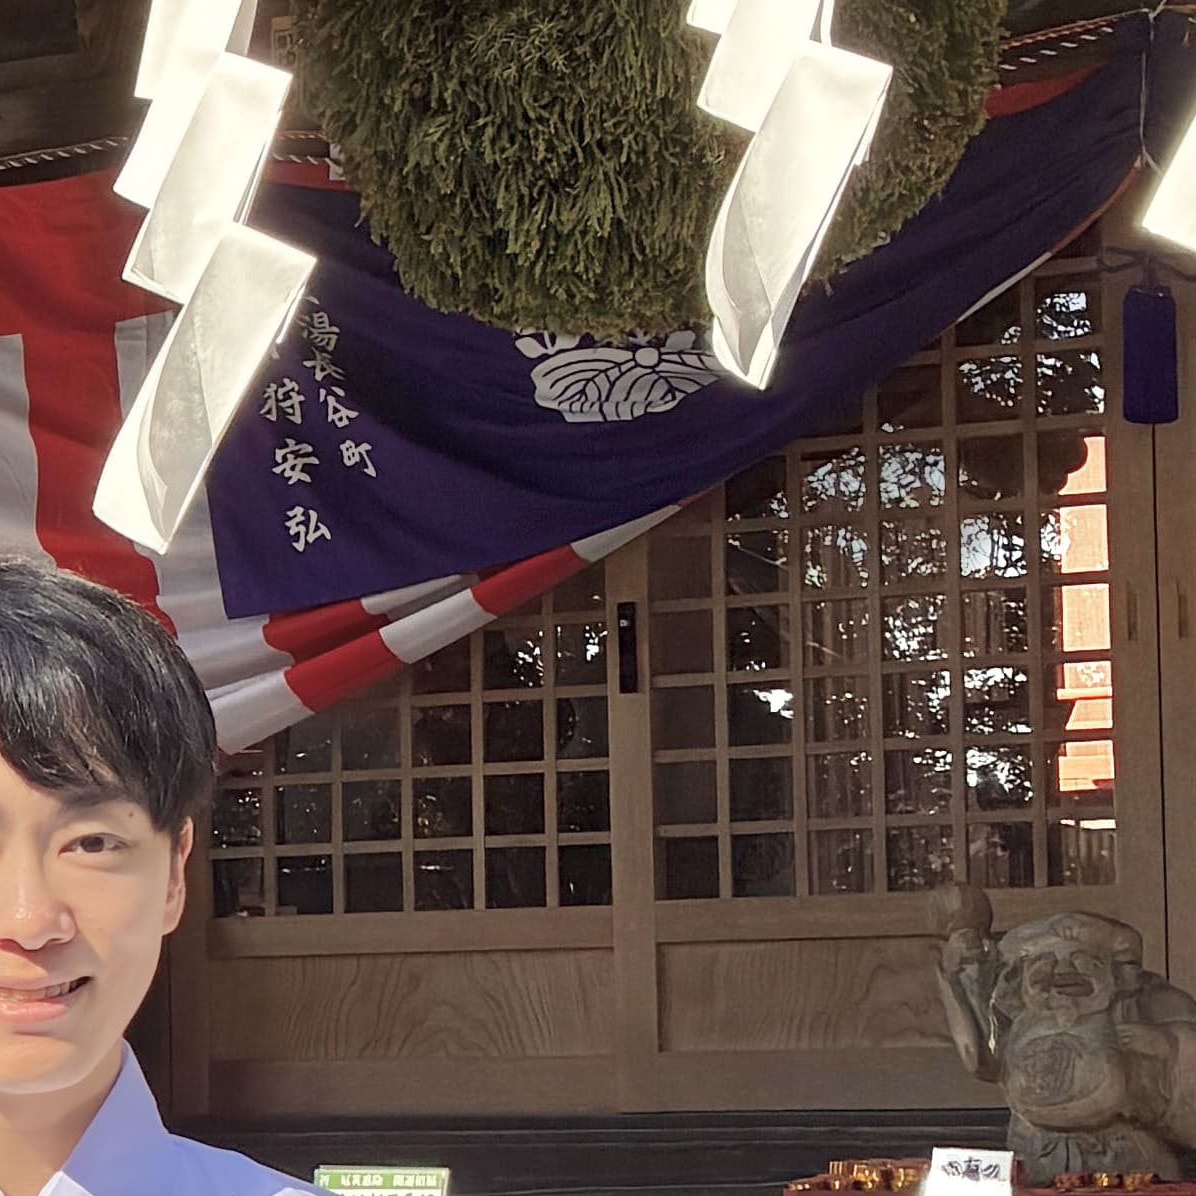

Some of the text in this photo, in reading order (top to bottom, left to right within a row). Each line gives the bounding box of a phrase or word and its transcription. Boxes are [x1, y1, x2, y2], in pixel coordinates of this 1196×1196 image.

[259, 345, 332, 553] 狩安弘
[296, 296, 377, 478] 湯長谷町
